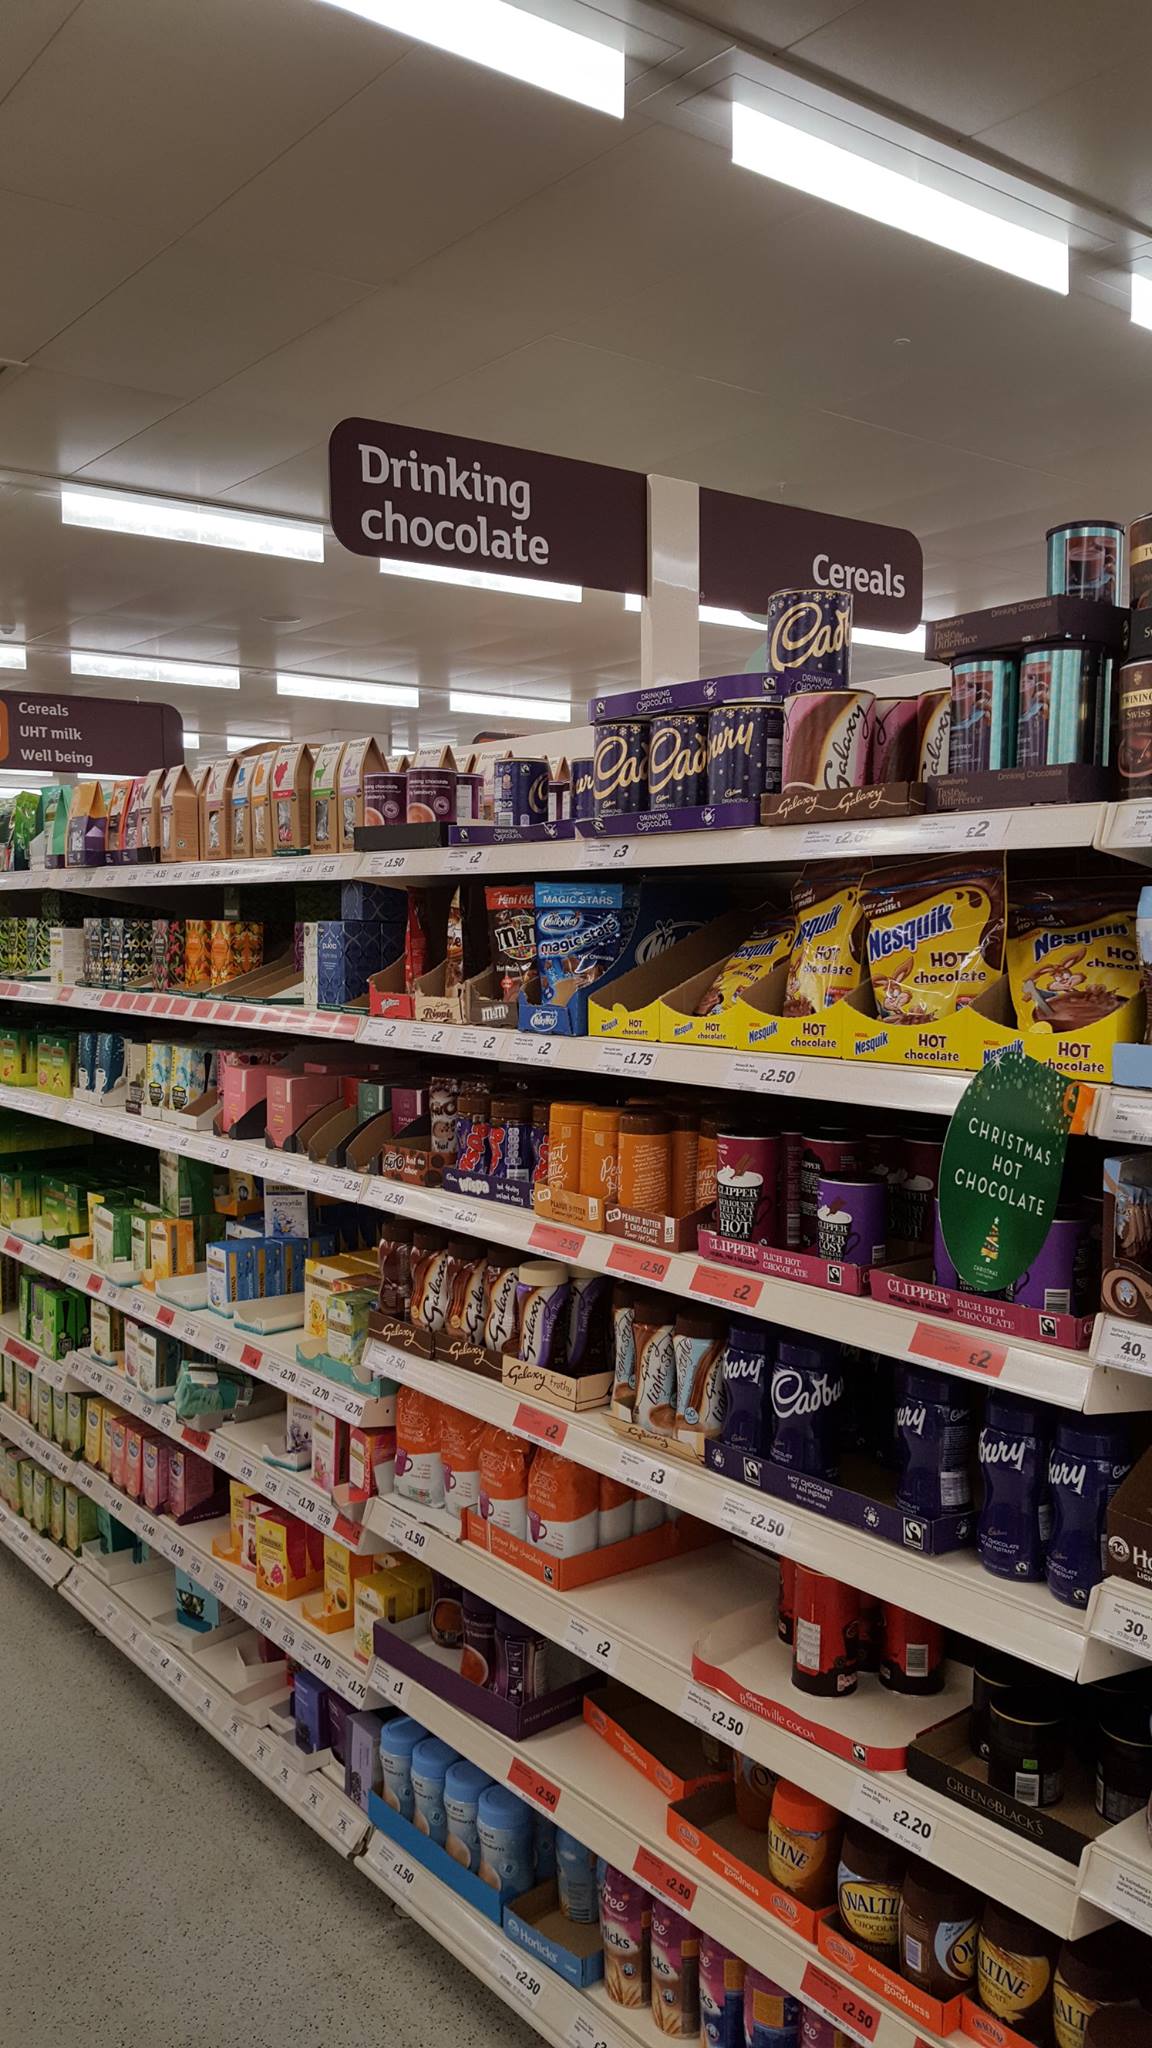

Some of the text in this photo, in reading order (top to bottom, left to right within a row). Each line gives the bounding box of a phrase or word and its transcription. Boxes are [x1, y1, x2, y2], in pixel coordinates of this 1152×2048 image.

[358, 444, 531, 519] Drinking
[361, 501, 549, 565] chocolate
[812, 554, 905, 598] Cereals
[991, 601, 1052, 617] Drinking Chocolate
[935, 631, 954, 641] Taste
[935, 634, 977, 650] Difference
[802, 674, 832, 685] DRINKING
[641, 689, 670, 702] DRINKING
[19, 702, 69, 716] Cereals
[637, 696, 673, 711] CHOCOLATE
[1126, 708, 1150, 720] Swiss
[20, 726, 82, 741] UHT milk
[21, 749, 93, 767] Well being
[998, 769, 1063, 781] Drinking Chocolate
[937, 786, 960, 798] Taste
[937, 792, 983, 806] Difference
[777, 794, 818, 817] Galaxy
[838, 788, 884, 814] Galaxy
[640, 812, 668, 821] DRINKING
[637, 818, 672, 831] CHOCOLATE
[965, 821, 990, 839] £2
[470, 852, 482, 863] £2
[614, 844, 628, 858] £3
[543, 896, 613, 904] MAGIC STARS
[875, 901, 901, 914] milk!
[541, 918, 618, 956] magic stars
[869, 904, 954, 961] Nesquik
[1034, 923, 1128, 961] Nesquik
[814, 946, 841, 961] HOT
[930, 952, 969, 967] HOT
[1107, 946, 1139, 962] HO
[747, 963, 762, 972] HOT
[803, 963, 853, 976] chocolate
[914, 970, 986, 985] chocolate
[601, 1018, 618, 1032] Nesquik
[628, 1019, 642, 1028] HOT
[674, 1021, 694, 1036] Nesquik
[705, 1023, 720, 1032] HOT
[802, 1022, 826, 1036] HOT
[385, 1026, 396, 1037] £2
[432, 1031, 443, 1042] £2
[697, 1032, 726, 1040] chocolate
[749, 1022, 778, 1043] Nesquik
[483, 1037, 496, 1048] £2
[538, 1042, 552, 1055] £2
[791, 1038, 837, 1048] chocolate
[855, 1032, 888, 1055] Nesquik
[918, 1034, 947, 1048] HOT
[904, 1050, 959, 1062] chocolate
[1058, 1042, 1091, 1058] HOT
[624, 1052, 654, 1066] £1.75
[760, 1069, 795, 1083] £2.50
[968, 1117, 1052, 1167] CHRISTMAS
[406, 1155, 417, 1165] hot
[992, 1154, 1023, 1180] HOT
[404, 1166, 418, 1175] choc
[459, 1177, 490, 1195] Wispa
[954, 1168, 1046, 1216] CHOCOLATE
[384, 1192, 404, 1205] £2.50
[608, 1212, 619, 1220] NEW
[622, 1212, 661, 1228] PEANUT BUTTER
[630, 1224, 658, 1238] CHOCOLATE
[720, 1221, 752, 1234] HOT
[818, 1222, 848, 1234] CLIPPER
[709, 1239, 756, 1258] CLIPPER
[763, 1252, 783, 1264] RICH
[785, 1258, 801, 1267] HOT
[641, 1261, 664, 1274] £2.50
[763, 1262, 808, 1278] CHOCOLATE
[733, 1285, 751, 1300] £2
[887, 1279, 948, 1306] CLIPPER
[489, 1270, 519, 1348] Galaxy
[956, 1298, 982, 1312] RICH
[984, 1306, 1005, 1317] HOT
[956, 1310, 1015, 1330] CHOCOLATE
[382, 1324, 415, 1346] Galaxy
[522, 1295, 548, 1362] Galaxy
[450, 1342, 486, 1365] Galaxy
[1121, 1342, 1145, 1360] 40p
[968, 1350, 992, 1369] £2
[280, 1369, 296, 1383] £2.70
[507, 1365, 572, 1396] Galaxy Frothy
[312, 1387, 329, 1400] £2.70
[345, 1402, 363, 1416] £2.70
[545, 1424, 559, 1439] £2
[650, 1469, 665, 1484] £3
[788, 1475, 833, 1496] HOT CHOCOLATE
[298, 1496, 315, 1512] £1.70
[317, 1511, 331, 1525] £1.70
[750, 1515, 785, 1537] £2.50
[405, 1527, 425, 1547] £1.50
[1124, 1619, 1147, 1641] 30p
[596, 1641, 611, 1658] £2
[313, 1651, 331, 1670] £1.70
[348, 1679, 366, 1698] £1.70
[394, 1681, 403, 1694] £1
[739, 1692, 785, 1725] Bournville
[786, 1717, 816, 1741] COCOA
[712, 1712, 743, 1737] £2.50
[535, 1786, 556, 1804] £2.50
[893, 1810, 931, 1839] £2.20
[393, 1861, 414, 1885] £1.50
[723, 1865, 759, 1897] goodness
[666, 1878, 691, 1900] £2.50
[520, 1928, 558, 1963] Horlicks
[515, 1967, 541, 1996] £2.50
[883, 1983, 931, 2020] goodness
[842, 2001, 873, 2028] £2.50
